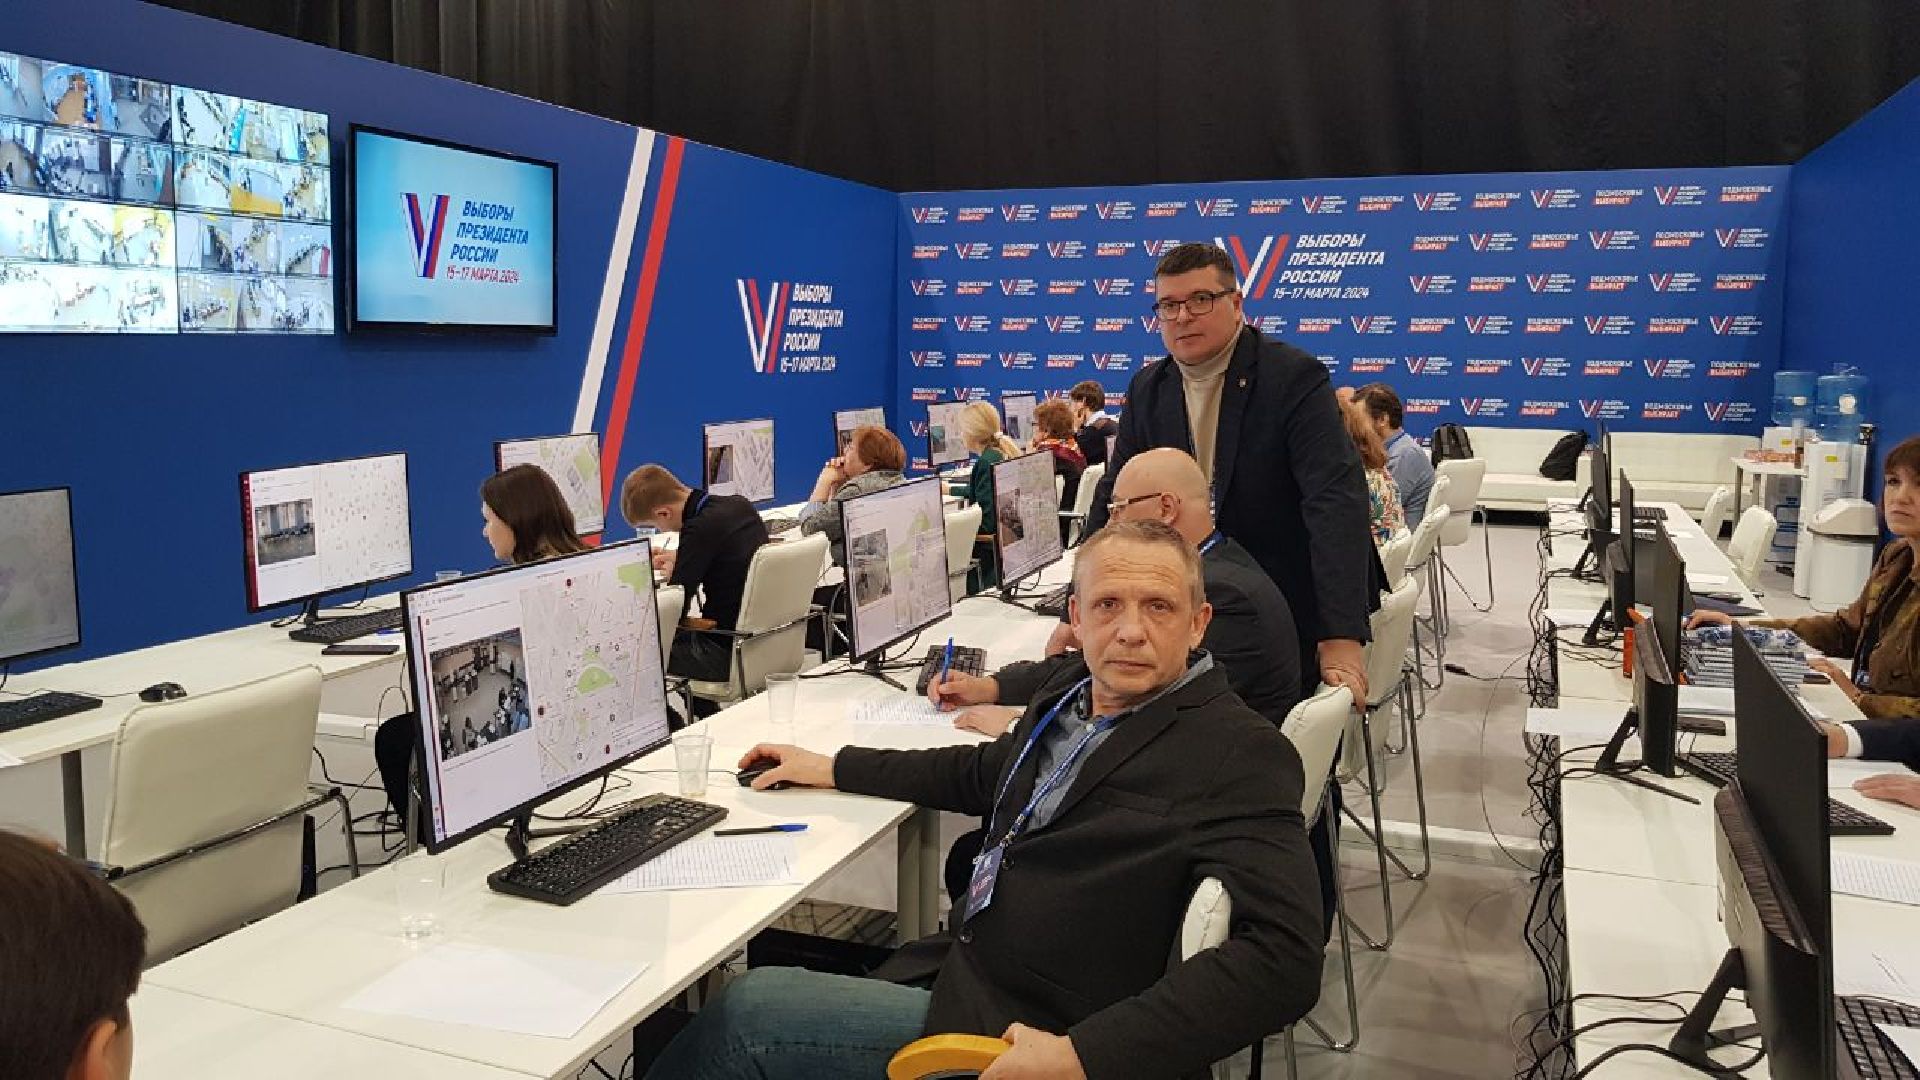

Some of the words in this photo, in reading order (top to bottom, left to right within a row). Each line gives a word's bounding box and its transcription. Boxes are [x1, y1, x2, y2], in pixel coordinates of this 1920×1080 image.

[463, 201, 514, 221] ВЫБОРЫ
[457, 223, 528, 245] ПРЕЗИДЕНТА
[1296, 233, 1366, 248] ВЫБОРЫ
[450, 244, 499, 263] РОССИИ
[1287, 251, 1385, 267] ПРЕЗИДЕНТА
[471, 267, 498, 283] МАРТА
[500, 270, 520, 284] 2024
[1279, 269, 1342, 284] РОССИИ
[793, 283, 833, 303] ВЫБОРЫ
[1303, 287, 1339, 299] МАРТА
[1341, 287, 1369, 299] 2024
[789, 308, 844, 330] ПРЕЗИДЕНТА
[783, 333, 821, 352] РОССИИ
